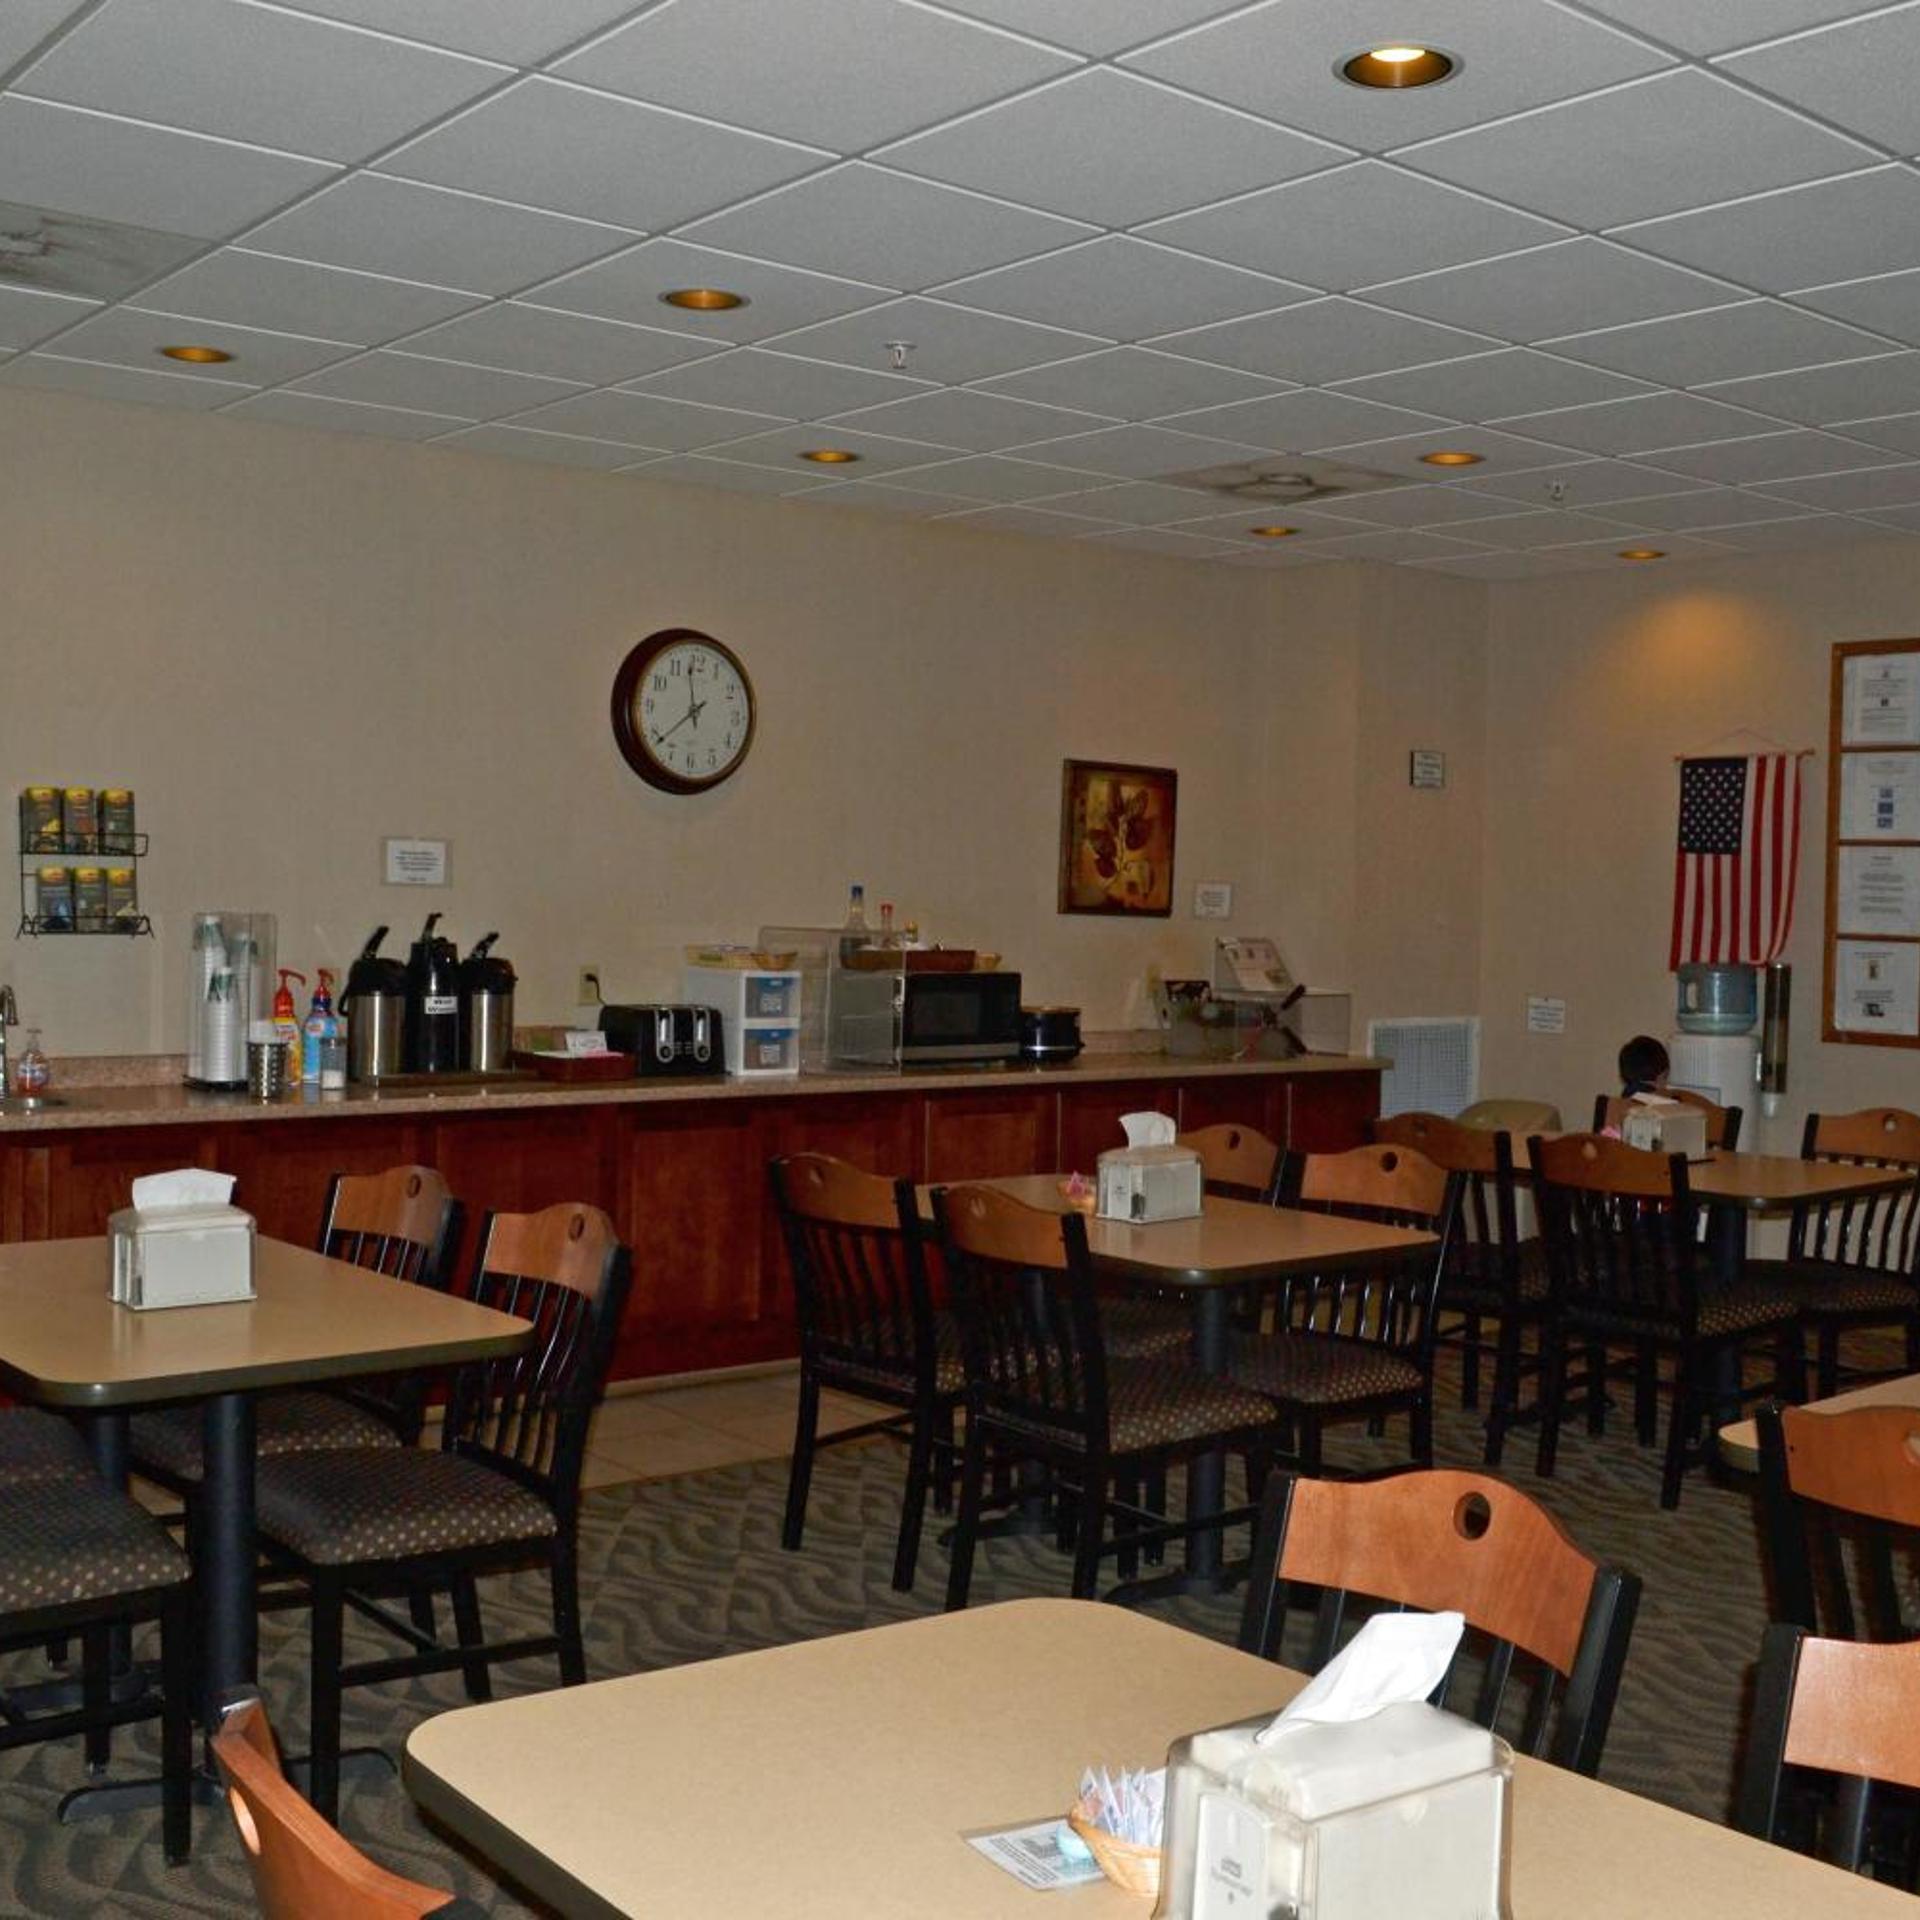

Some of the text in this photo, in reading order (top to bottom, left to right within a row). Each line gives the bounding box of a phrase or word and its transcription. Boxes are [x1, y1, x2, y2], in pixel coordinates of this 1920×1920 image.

[670, 659, 681, 677] 11
[713, 661, 720, 681] 1
[653, 674, 668, 692] 10
[725, 682, 736, 700] 2
